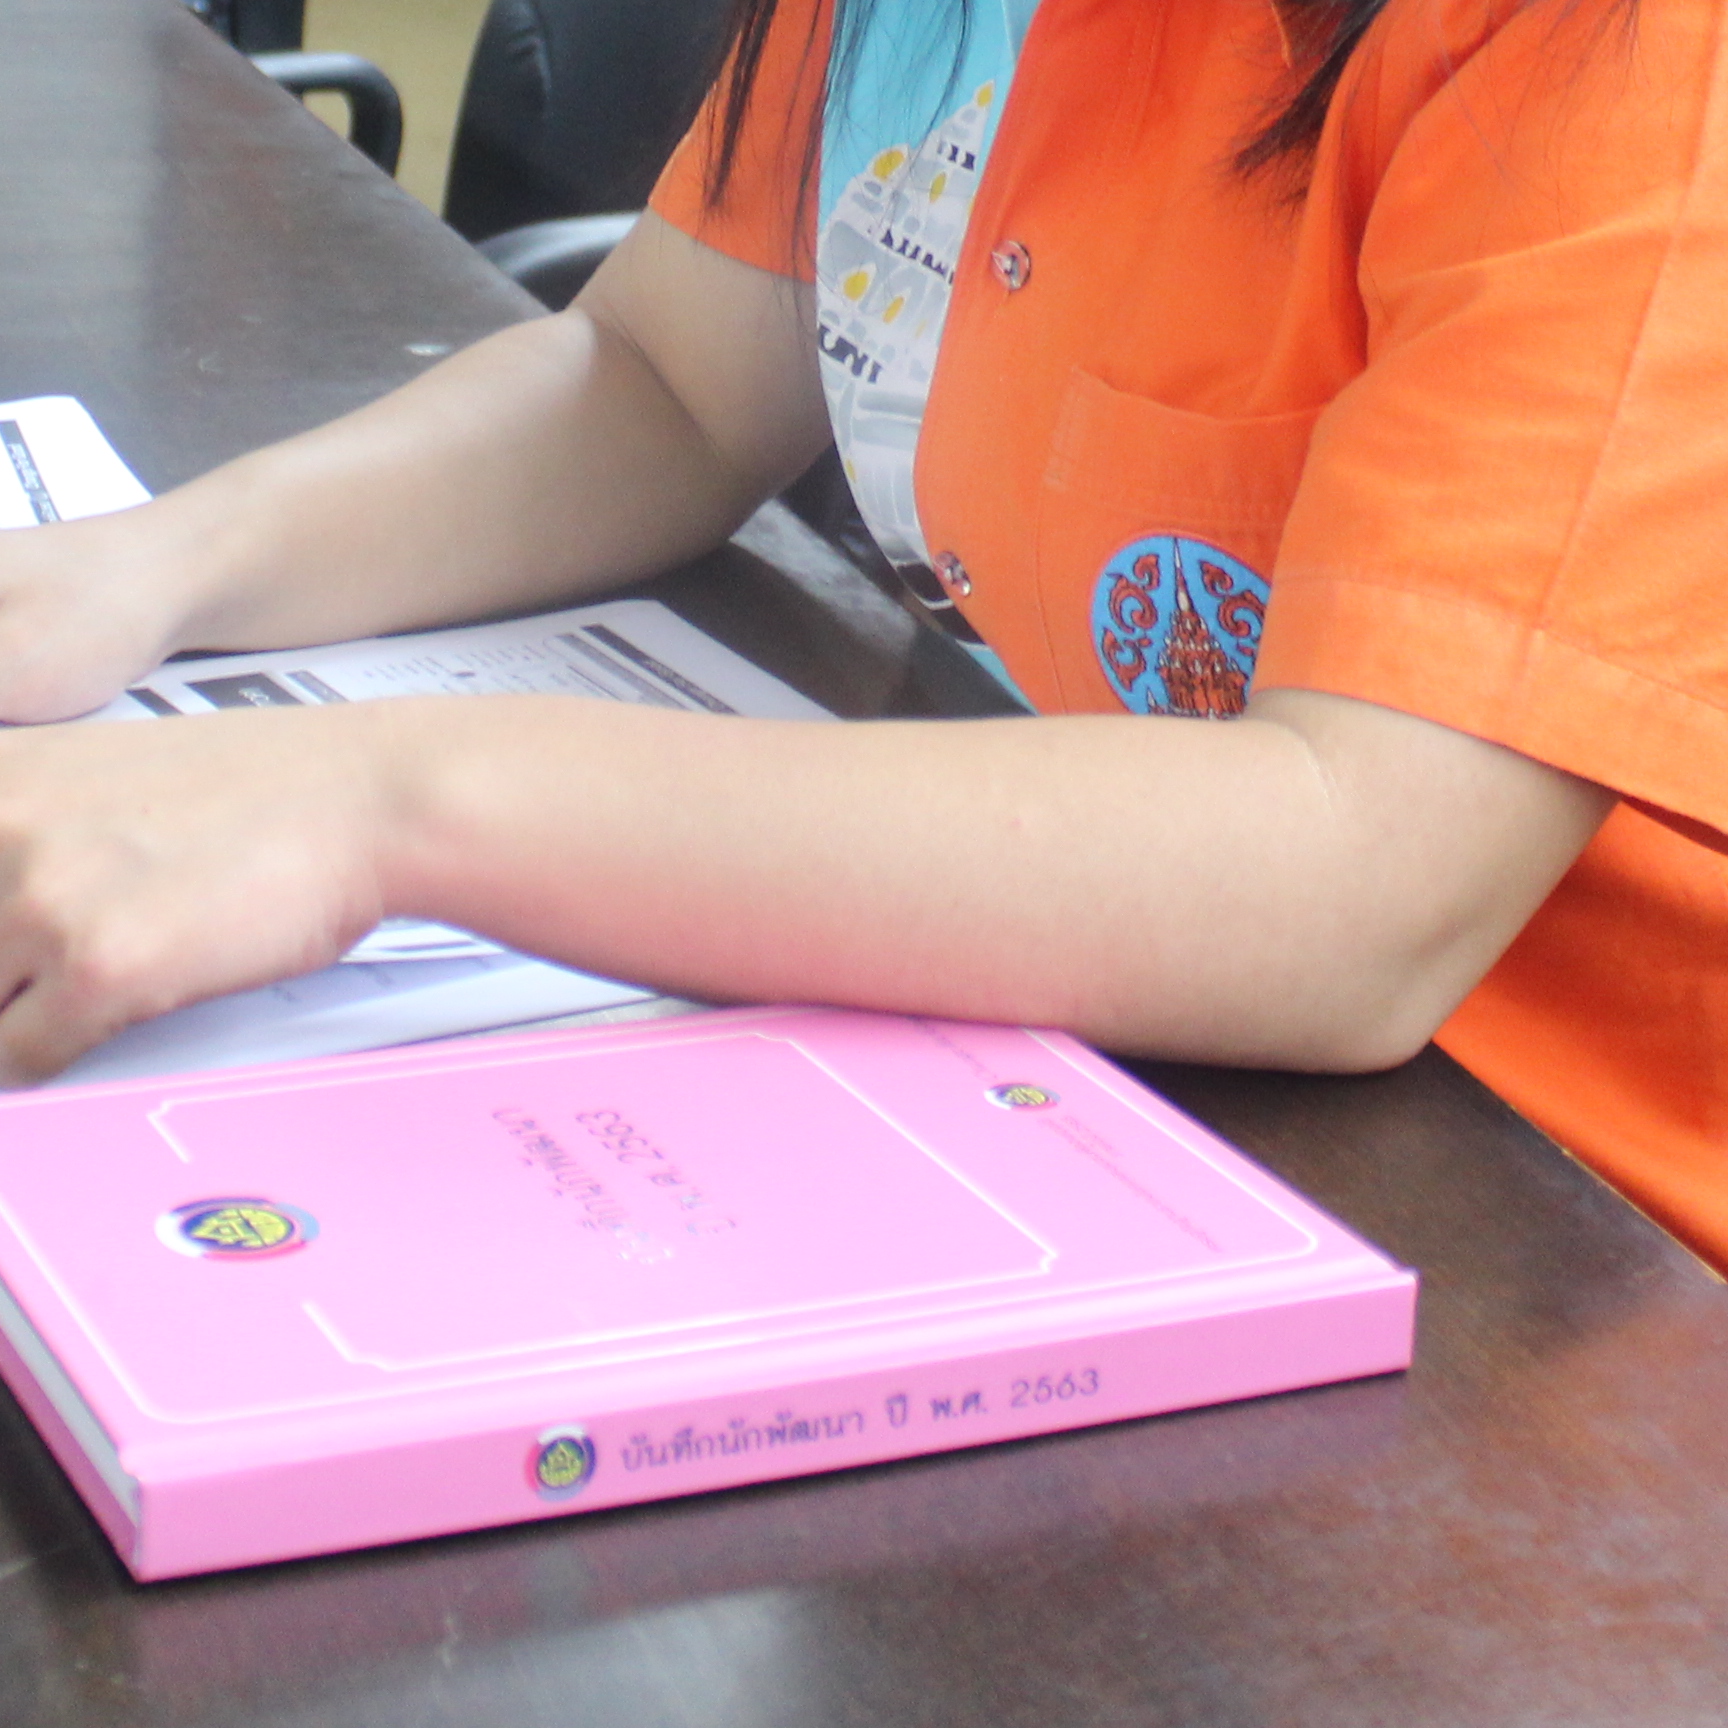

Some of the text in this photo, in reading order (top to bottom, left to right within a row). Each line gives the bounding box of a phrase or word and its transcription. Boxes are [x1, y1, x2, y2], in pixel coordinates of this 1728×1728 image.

[621, 1409, 865, 1473] บันทึกนักพัฒนา
[886, 1392, 910, 1428] ปี
[1010, 1368, 1101, 1409] 2563
